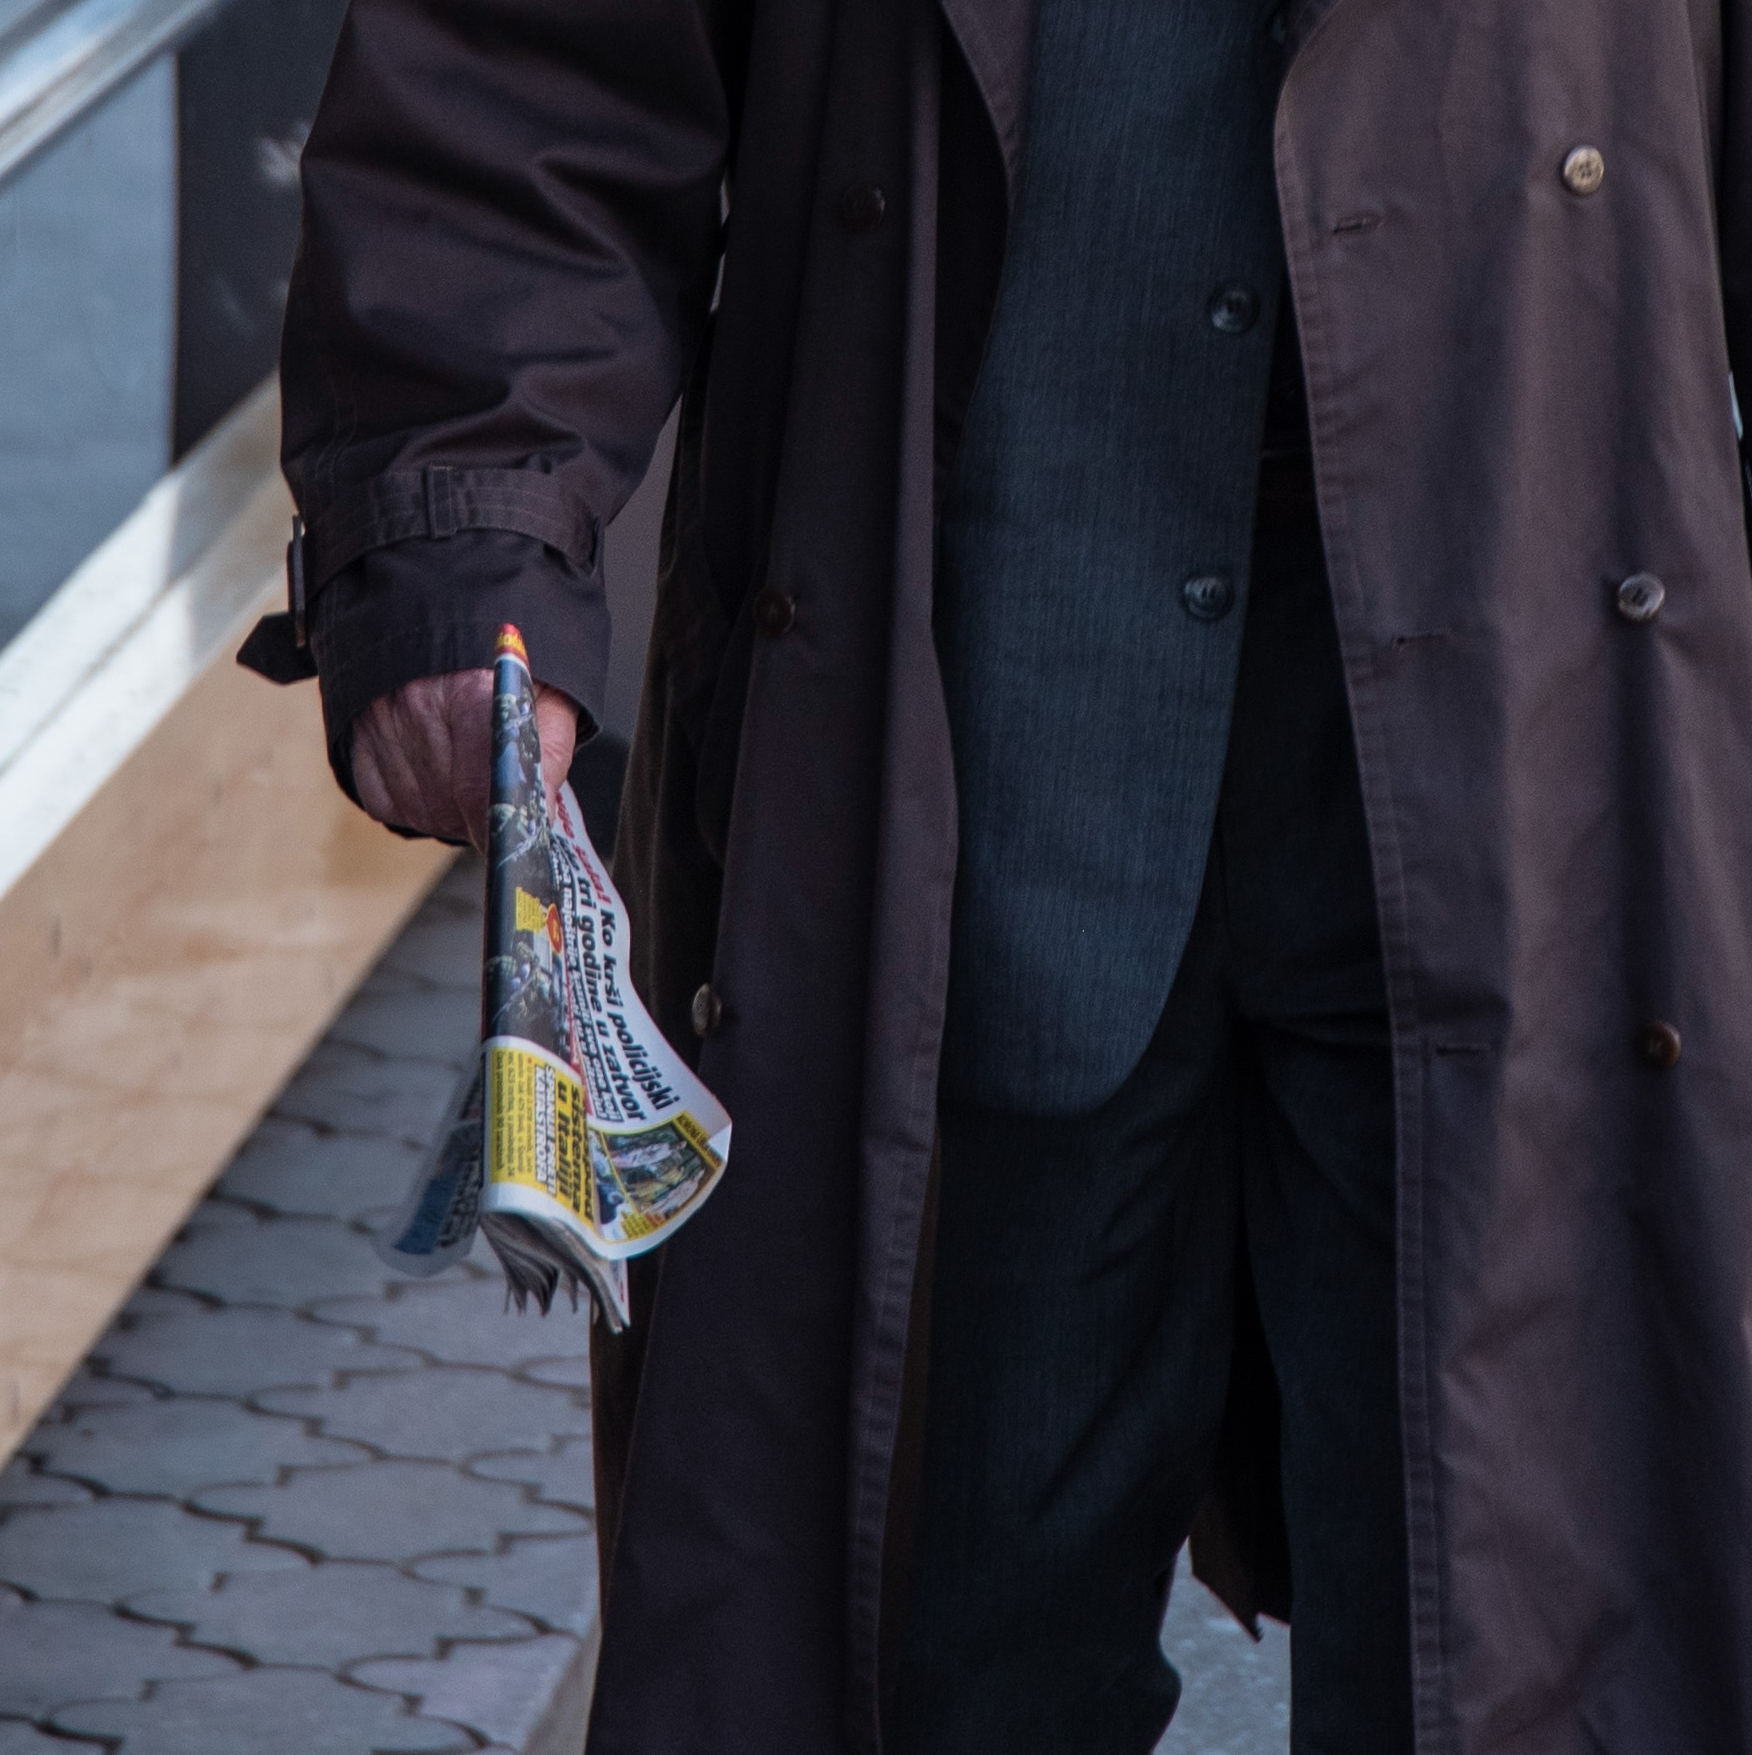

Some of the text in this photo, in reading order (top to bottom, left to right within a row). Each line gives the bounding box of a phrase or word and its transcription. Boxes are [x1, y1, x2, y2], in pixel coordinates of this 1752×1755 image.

[577, 876, 597, 910] tri
[600, 908, 617, 948] Ko
[576, 913, 603, 1013] godine
[603, 953, 624, 1008] krši
[595, 1019, 610, 1038] u
[606, 1011, 681, 1111] policijski
[535, 1065, 547, 1183] KATASTROFA
[602, 1043, 647, 1120] zatvor
[556, 1079, 575, 1201] u Italiji
[571, 1084, 584, 1214] sistema
